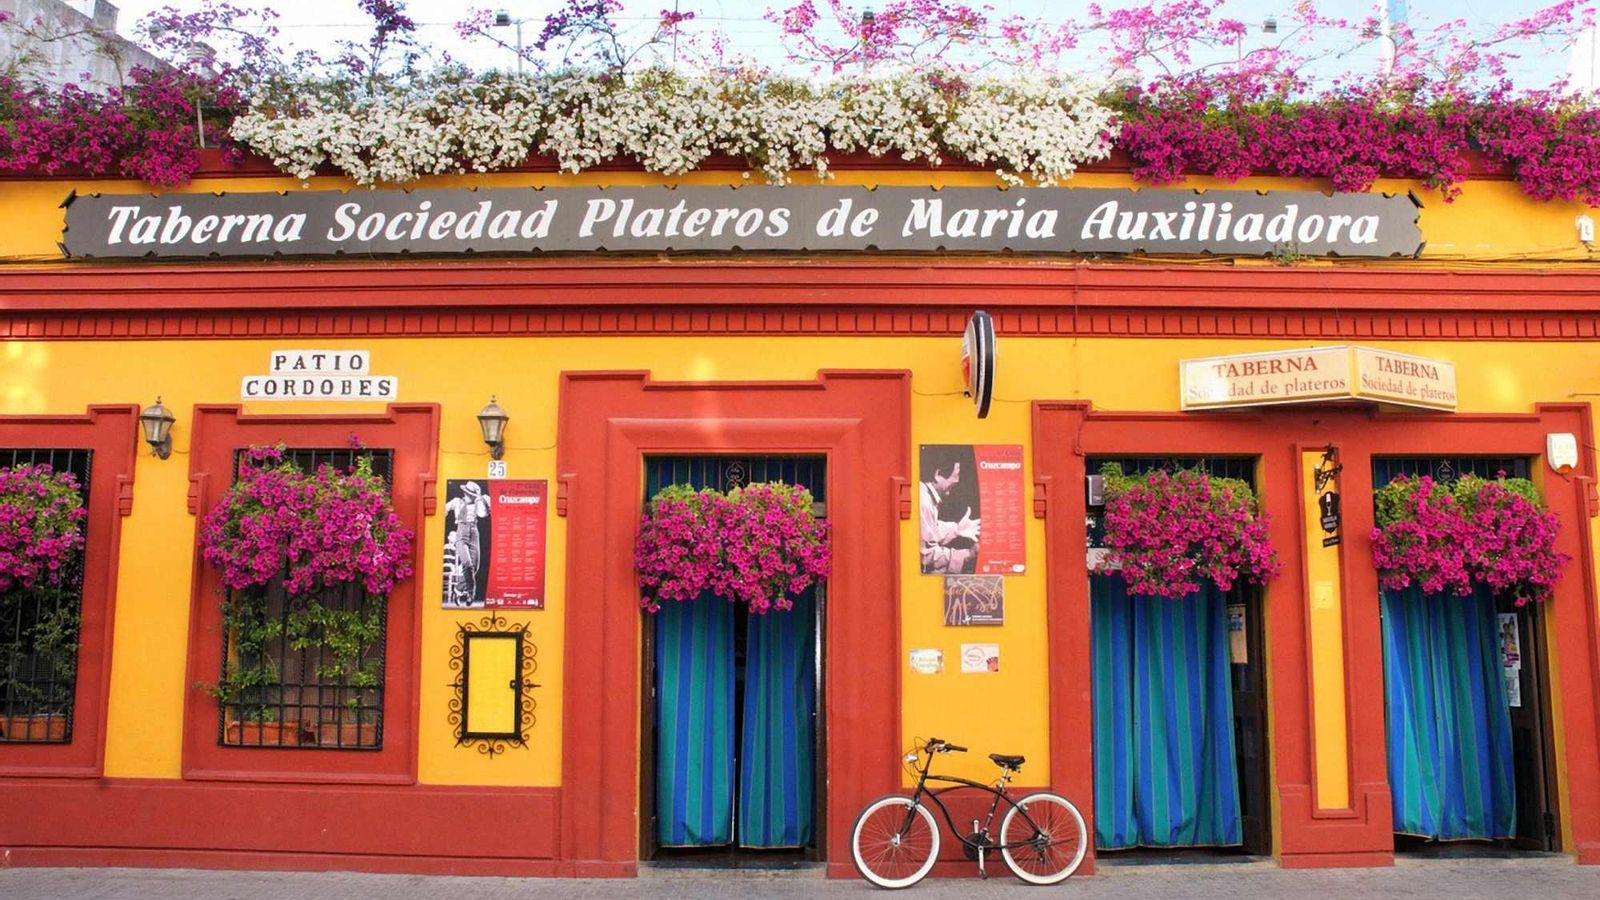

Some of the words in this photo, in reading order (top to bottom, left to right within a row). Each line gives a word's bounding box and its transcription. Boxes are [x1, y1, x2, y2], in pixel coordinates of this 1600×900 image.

[107, 205, 306, 244] Taberna
[327, 200, 558, 242] Sociedad
[578, 198, 791, 238] Plateros
[815, 198, 879, 238] de
[901, 197, 1058, 239] María
[1081, 200, 1380, 243] Auxiliadora
[274, 354, 363, 370] PATIO
[1212, 356, 1318, 378] TABERNA
[1375, 356, 1439, 381] TABERNA
[246, 379, 391, 396] CORDOBES
[1189, 381, 1254, 400] Sodad
[1260, 379, 1278, 395] de
[1285, 377, 1346, 396] plateros
[1362, 373, 1403, 394] Sociedad
[1407, 380, 1417, 396] de
[1421, 383, 1456, 401] plateros
[489, 462, 505, 477] 25
